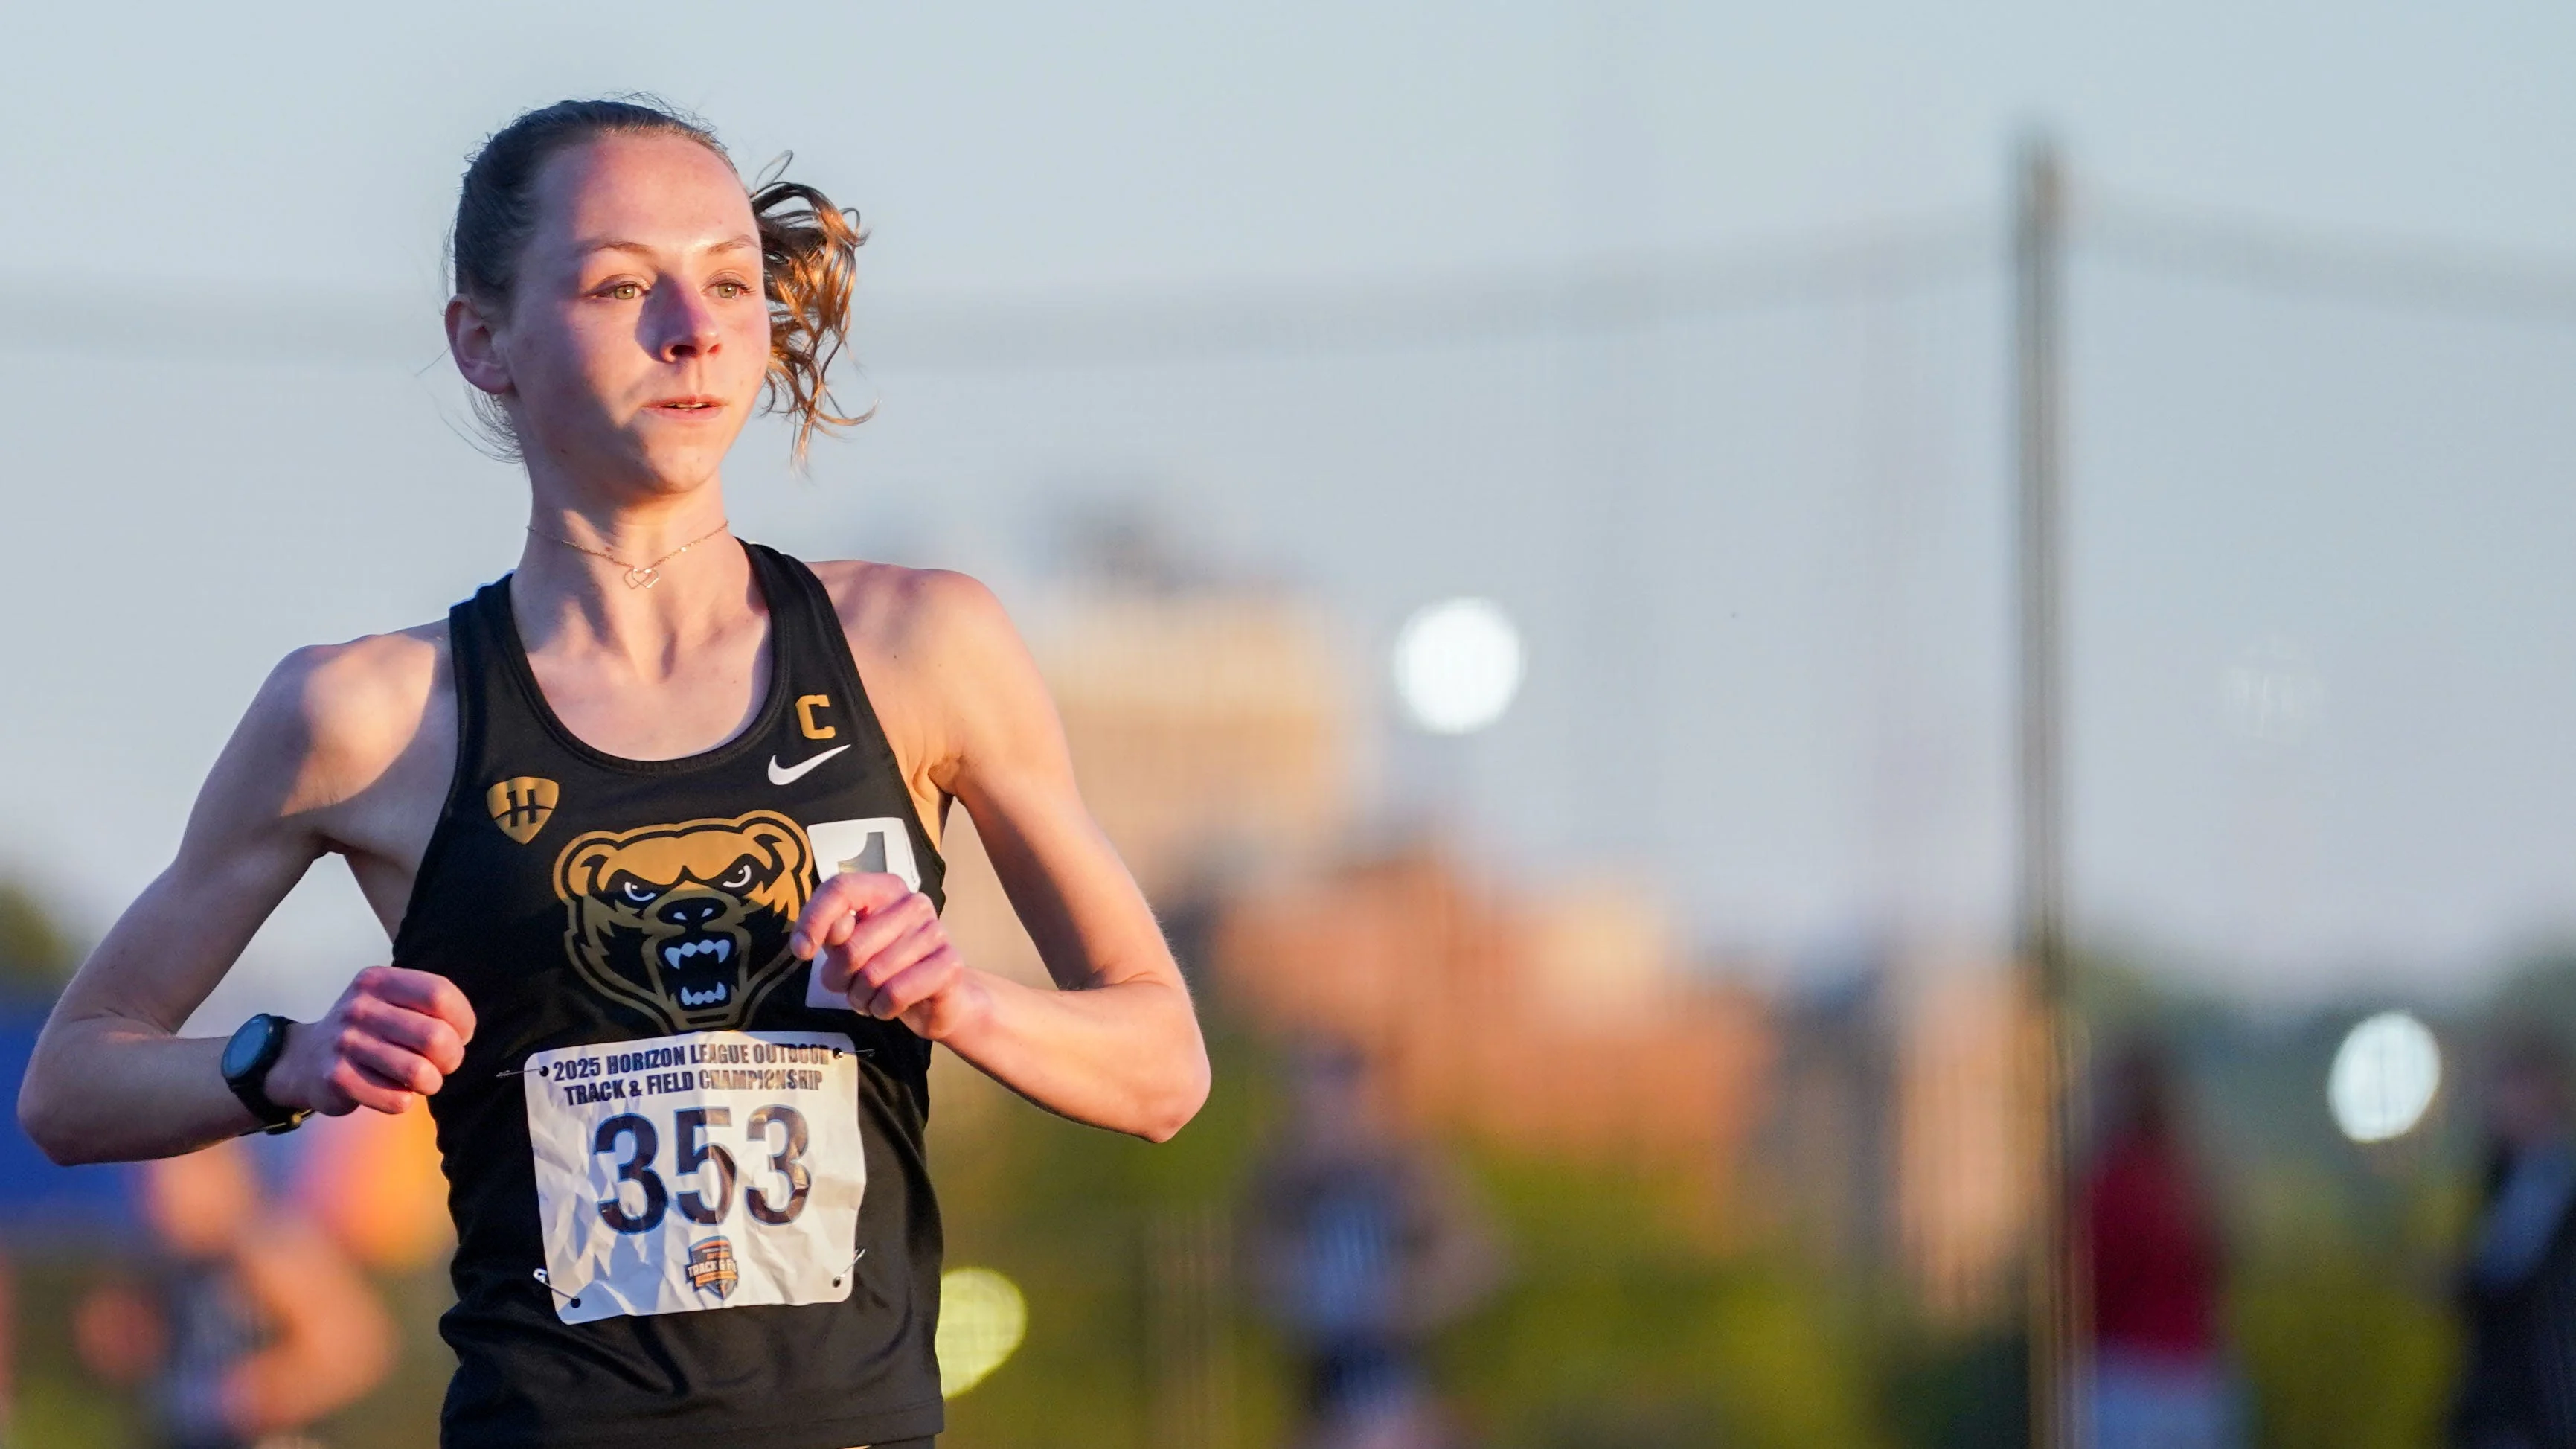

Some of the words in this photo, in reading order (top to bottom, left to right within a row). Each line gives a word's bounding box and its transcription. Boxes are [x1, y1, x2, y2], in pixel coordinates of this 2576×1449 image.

[795, 694, 836, 740] C
[553, 1057, 602, 1081] 2025
[606, 1046, 685, 1075] HORIZON
[690, 1043, 750, 1065] LEAGUE
[752, 1043, 830, 1065] OUTDOOR
[564, 1079, 627, 1106] TRACK
[629, 1080, 643, 1097] &
[646, 1071, 694, 1095] FIELD
[699, 1069, 823, 1090] CHAMPIONSHIP
[593, 1104, 812, 1236] 353
[687, 1260, 717, 1278] TRACK
